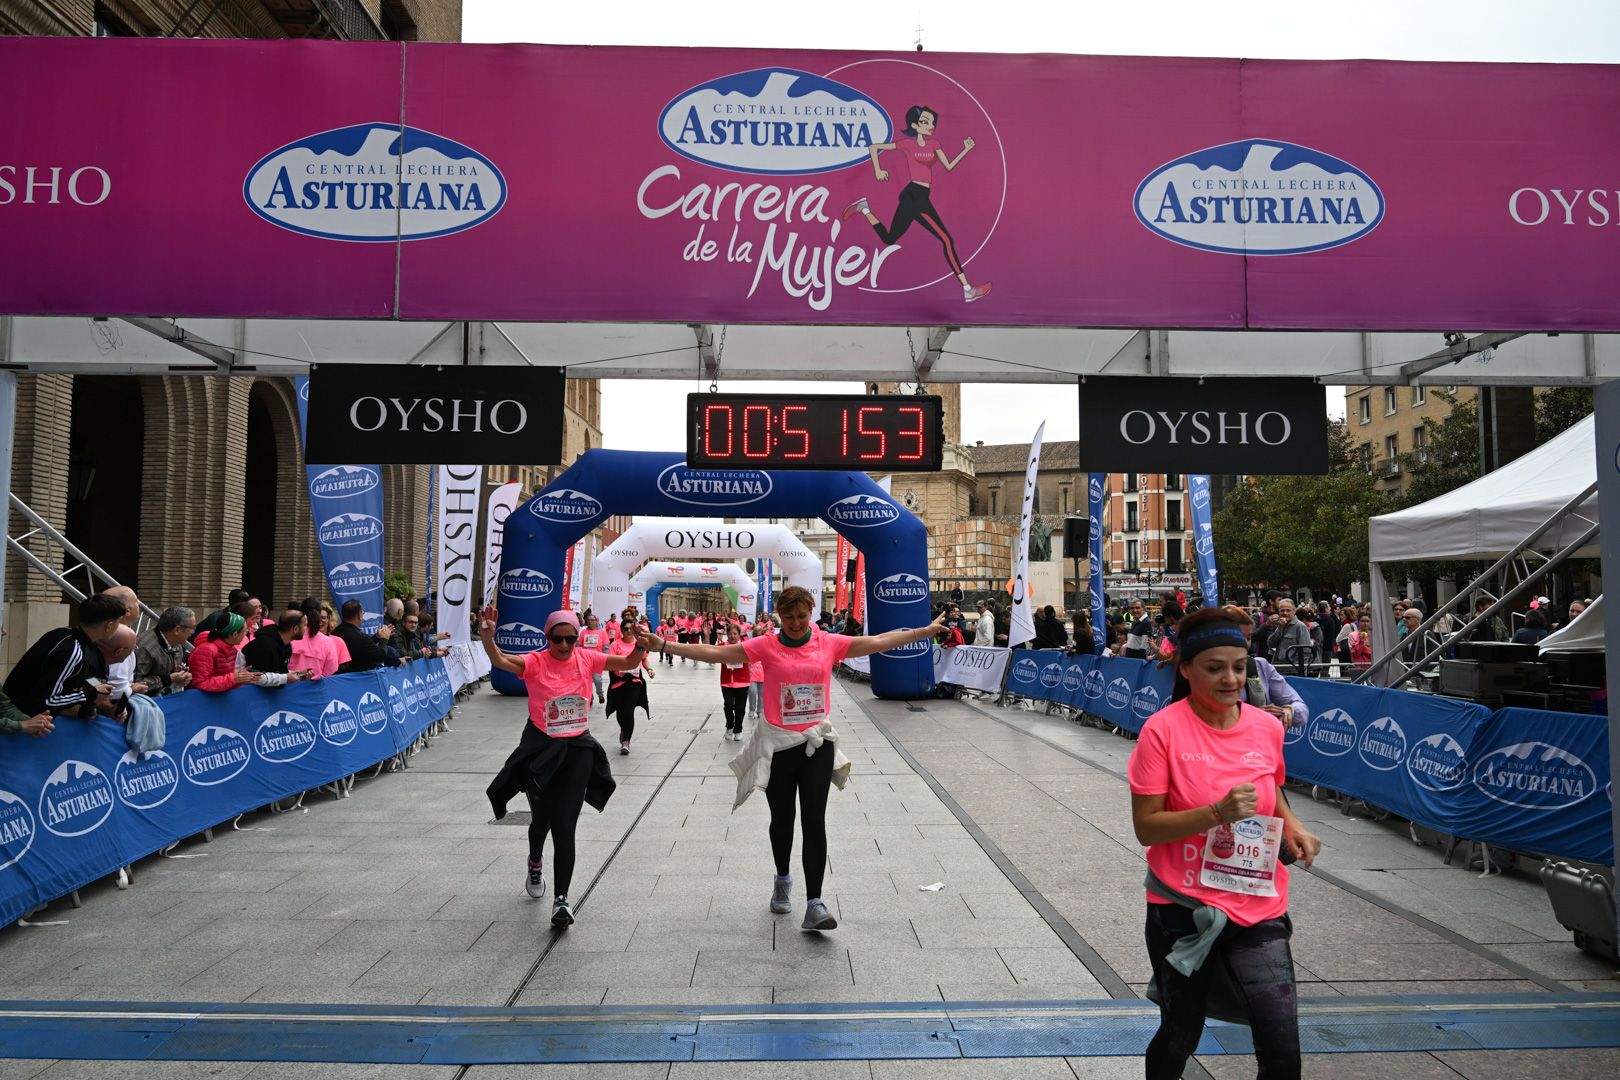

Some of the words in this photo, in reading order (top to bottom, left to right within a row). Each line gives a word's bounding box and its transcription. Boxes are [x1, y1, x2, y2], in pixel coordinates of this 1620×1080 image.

[713, 103, 786, 115] CENTRAL
[794, 106, 868, 117] LECHERA
[675, 105, 874, 148] ASTURIANA
[306, 164, 386, 175] CENTRAL
[395, 164, 478, 176] LECHERA
[263, 165, 486, 210] ASTURIANA
[636, 165, 830, 223] Carrera
[1192, 178, 1270, 190] CENTRAL
[1278, 180, 1358, 191] LECHERA
[1154, 181, 1366, 225] ASTURIANA
[1508, 187, 1620, 227] OYS
[682, 224, 719, 263] de
[727, 224, 753, 264] la
[746, 218, 902, 311] Mujer
[350, 396, 528, 434] OYSHO
[1119, 410, 1291, 446] OYSHO
[665, 472, 764, 494] ASTURIANA
[1140, 474, 1149, 513] OTEL
[534, 500, 596, 515] ASTURIANA
[833, 507, 895, 519] ASTURIANA
[665, 530, 755, 549] OYSHO
[501, 581, 549, 593] ASTURIANA
[877, 585, 926, 597] ASTURIANA
[954, 648, 995, 670] OYSHO
[324, 718, 357, 738] ASTURIANA
[1311, 722, 1352, 747] ASTURIANA
[261, 730, 313, 755] ASTURIANA
[1360, 731, 1402, 761] ASTURIAN
[187, 746, 247, 777] ASTURIANA
[120, 768, 176, 798] ASTURIANA
[1481, 761, 1585, 798] ASTURIANA
[47, 786, 111, 826] ASTURIANA
[1237, 843, 1260, 858] 016
